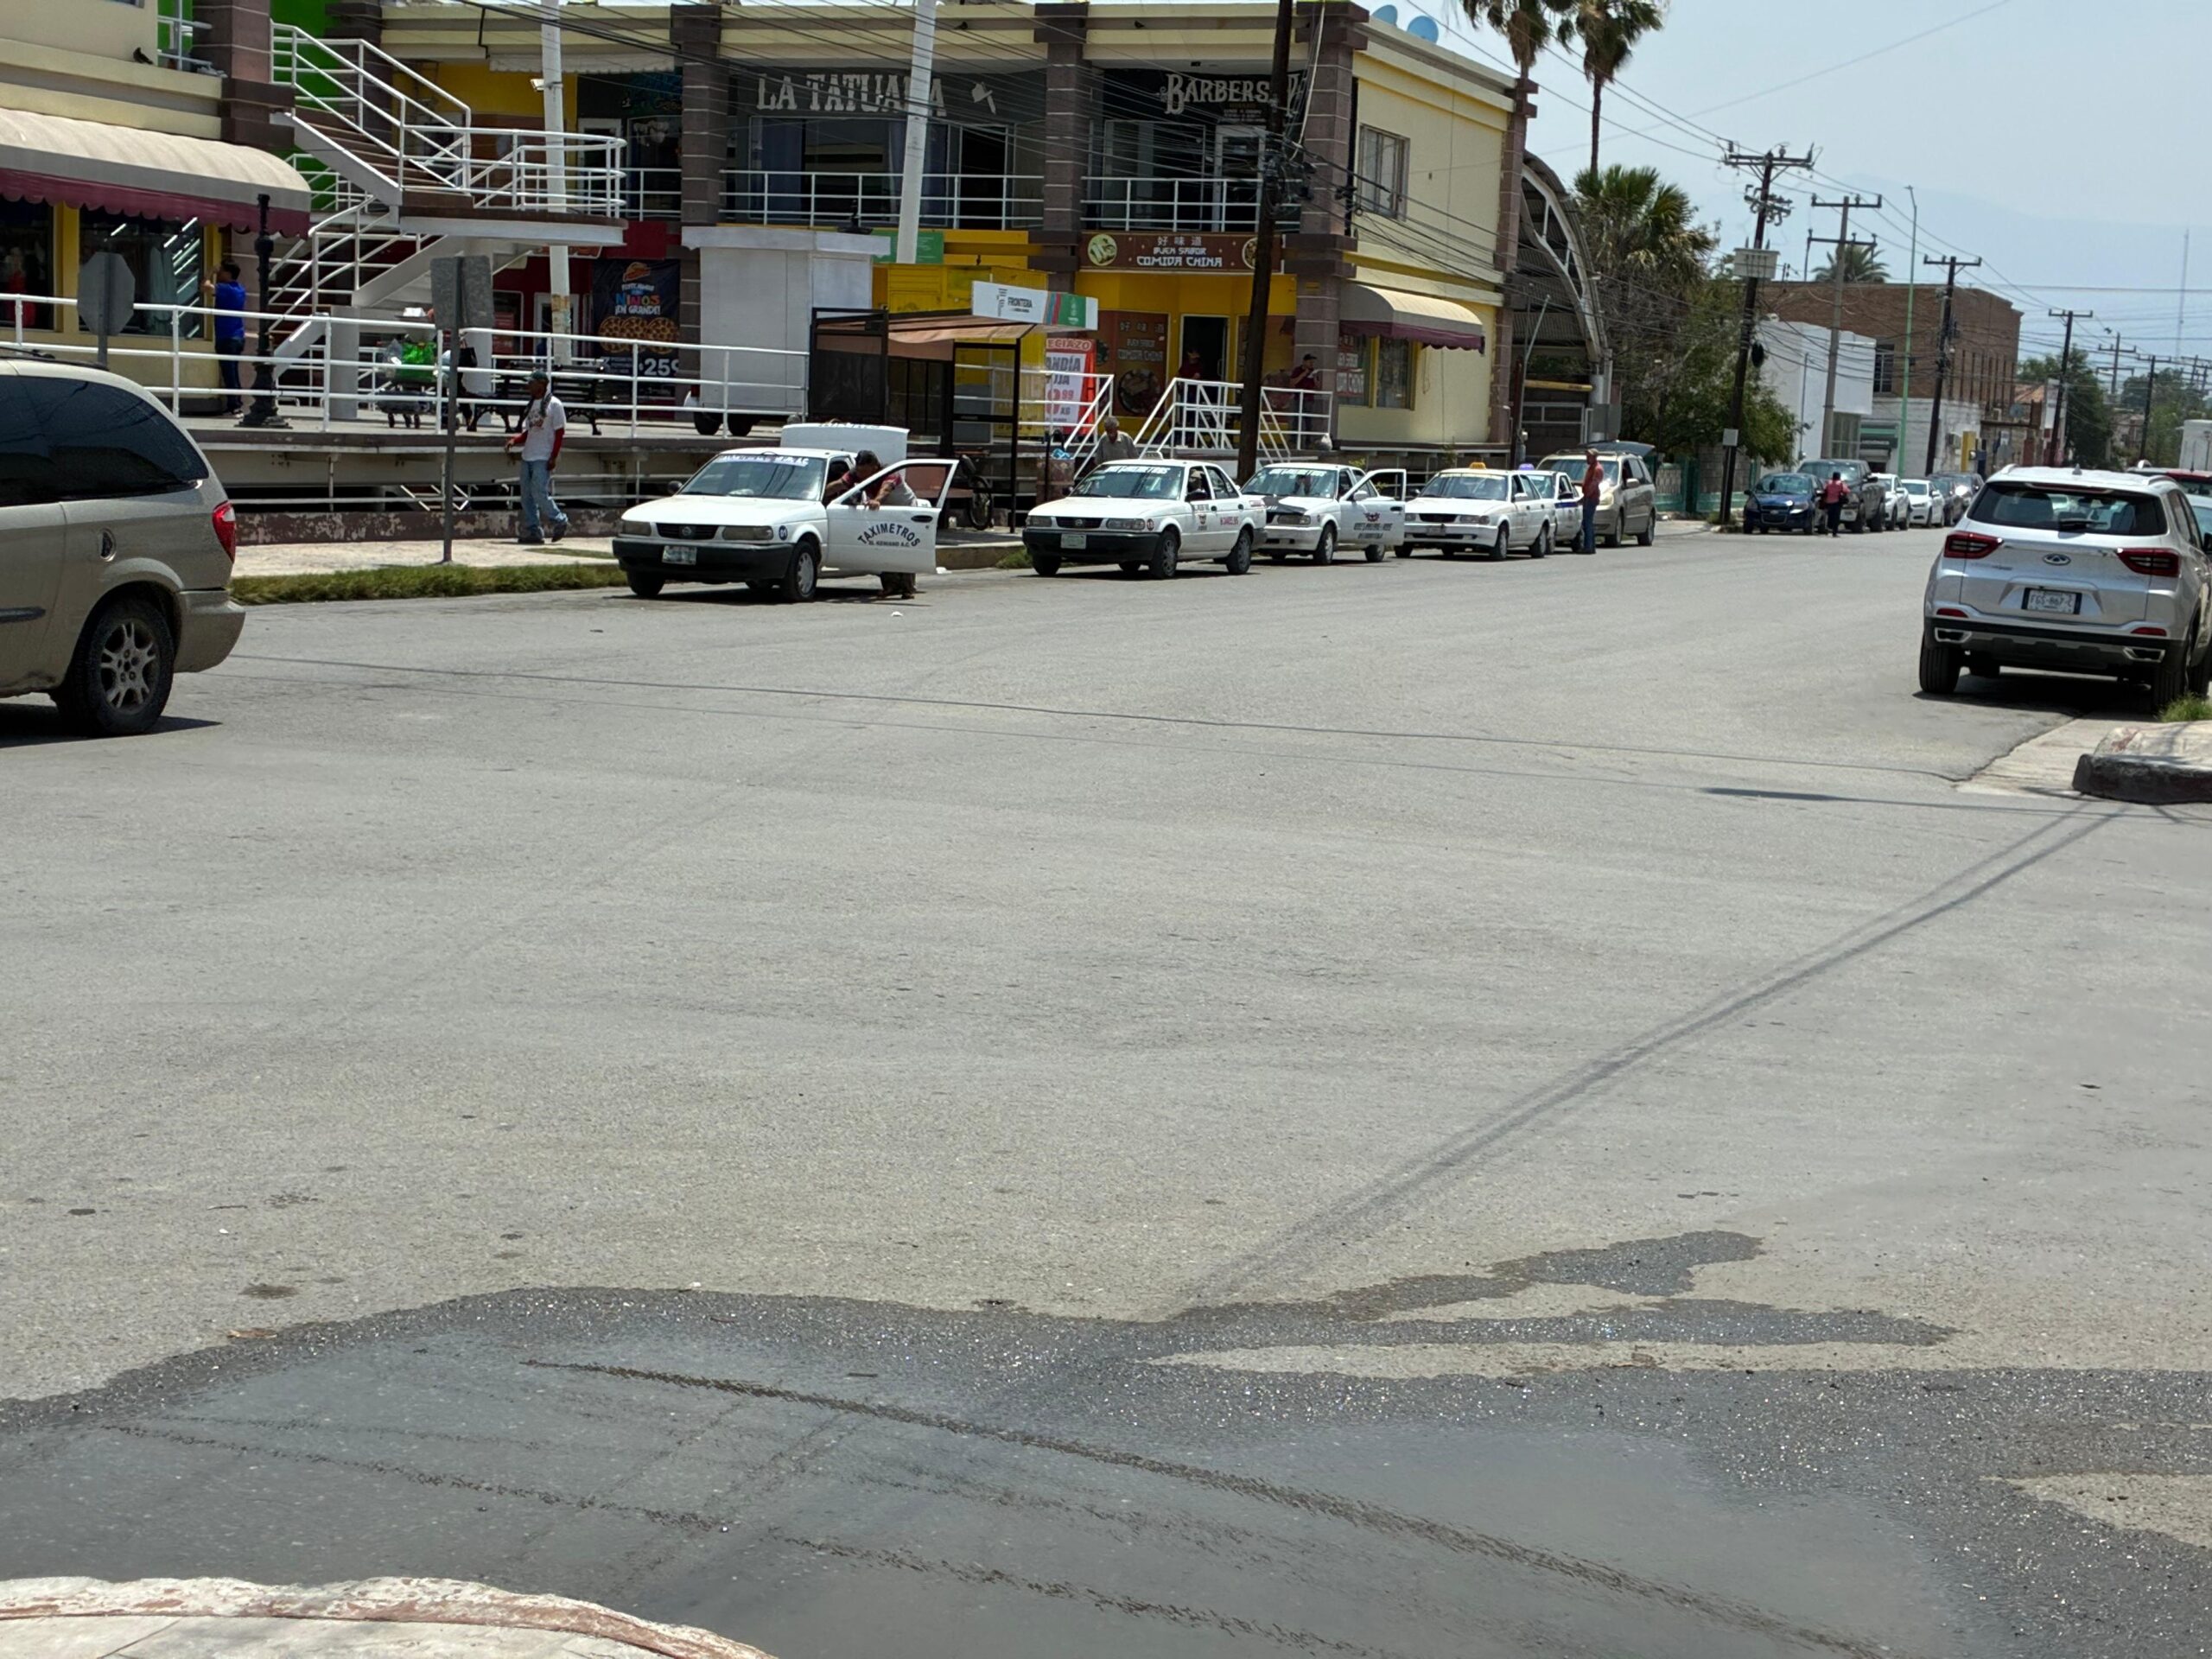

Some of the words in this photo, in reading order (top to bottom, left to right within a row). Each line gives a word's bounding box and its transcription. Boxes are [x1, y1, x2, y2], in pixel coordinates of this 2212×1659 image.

[757, 73, 798, 110] LA
[806, 74, 947, 117] TATUAA
[1136, 256, 1182, 267] COMIDA
[1185, 257, 1223, 267] CHINA
[857, 523, 921, 547] TAXIMETROS
